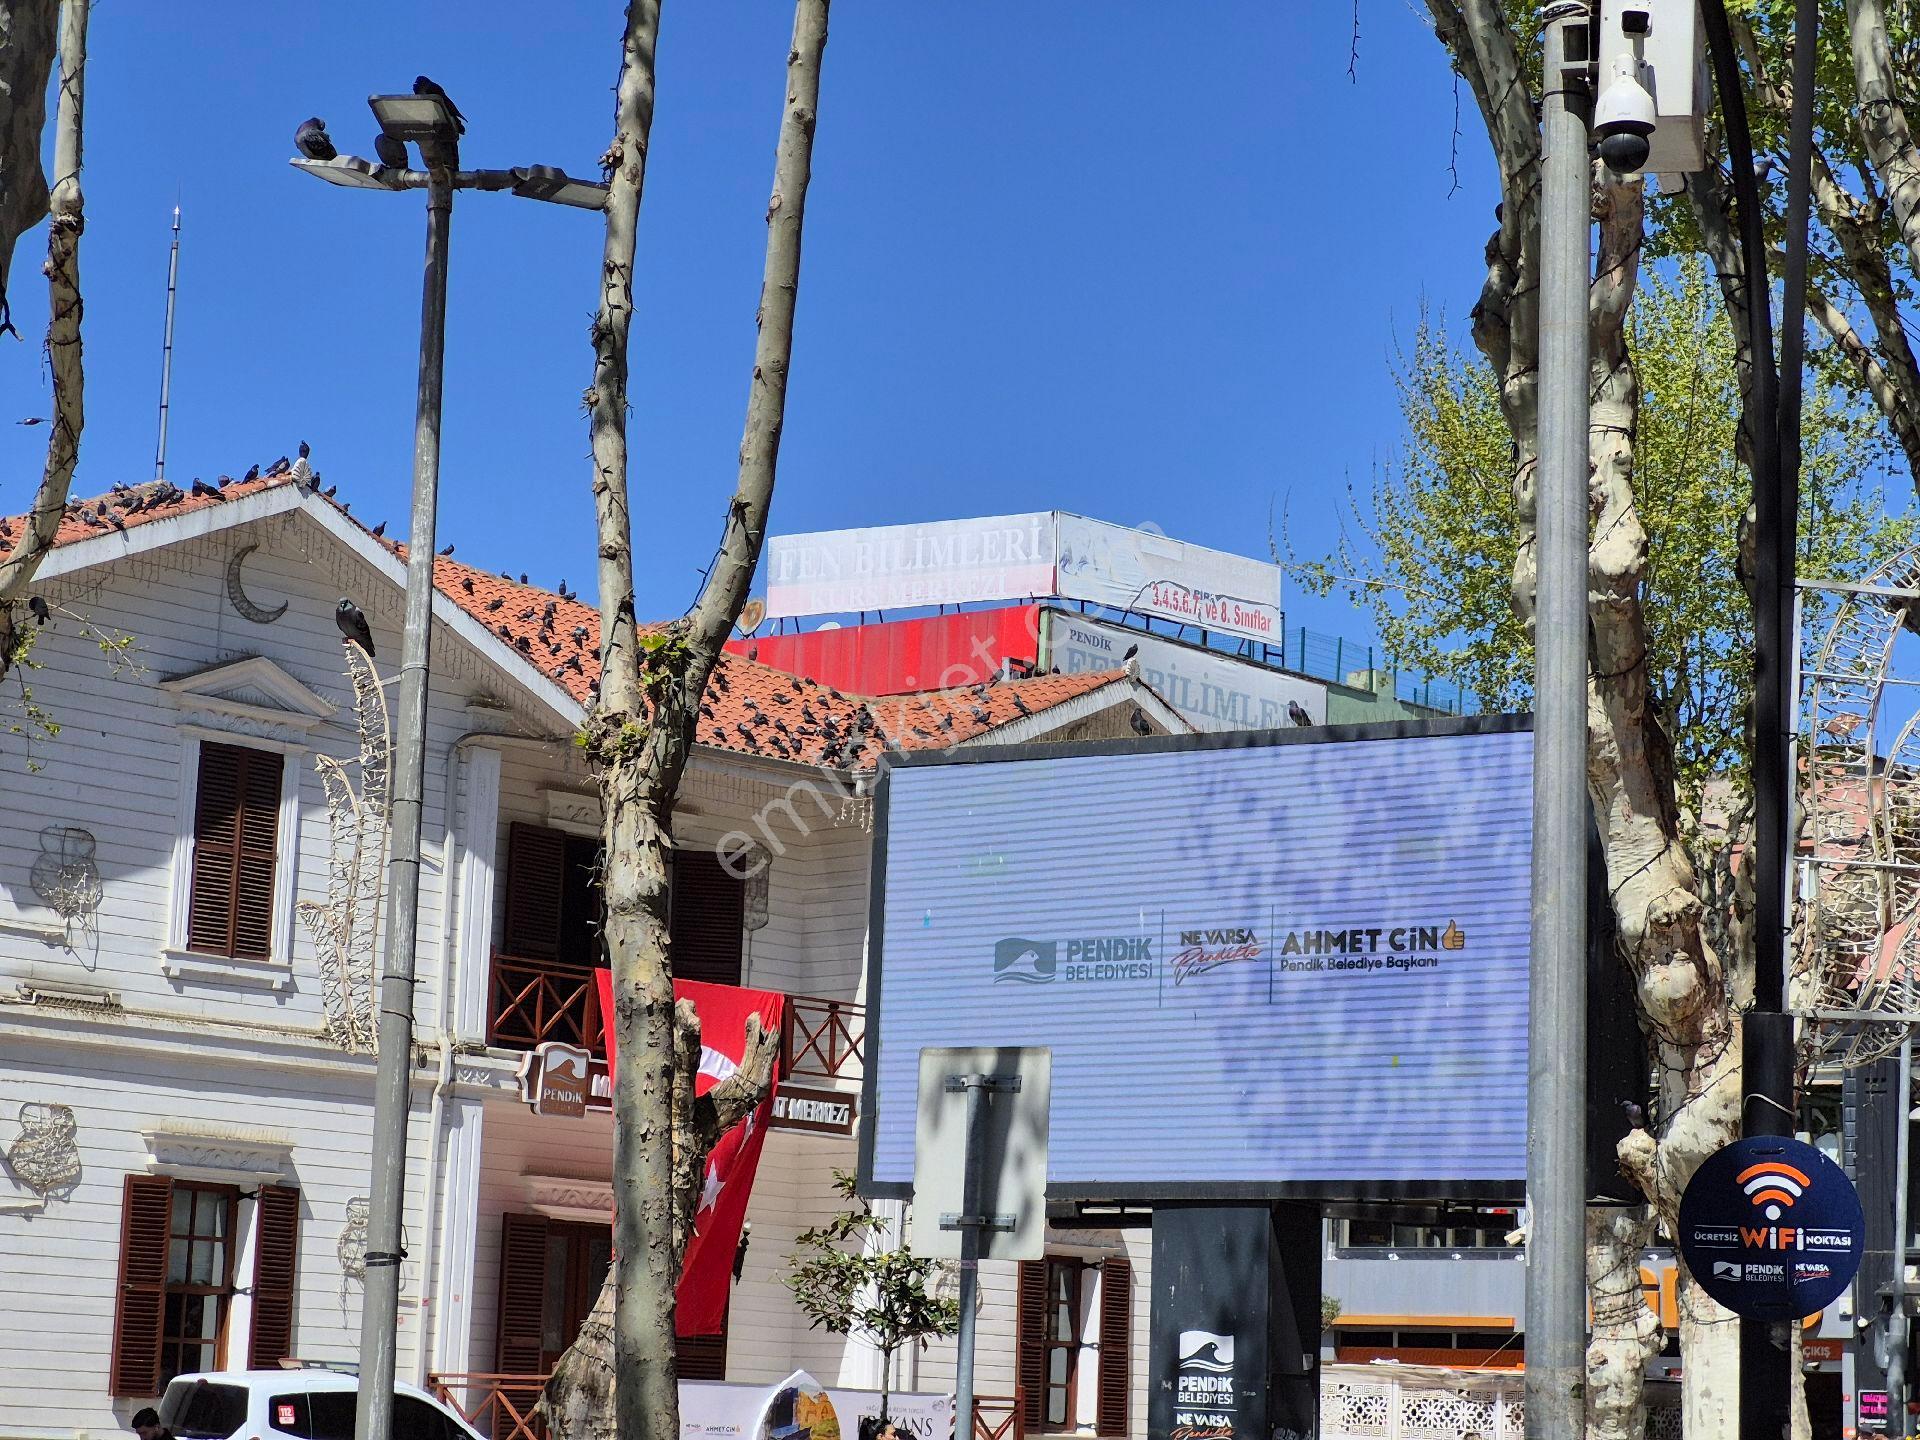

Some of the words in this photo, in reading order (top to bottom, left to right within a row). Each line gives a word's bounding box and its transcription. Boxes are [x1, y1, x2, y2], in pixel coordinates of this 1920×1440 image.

[777, 544, 842, 581] FEN
[1205, 602, 1218, 621] ve
[1234, 604, 1273, 633] Sınıflar
[1069, 627, 1112, 652] PENDİK
[1180, 930, 1202, 946] NE
[1204, 928, 1258, 945] VARSA
[1280, 929, 1383, 956] AHMET
[1280, 958, 1324, 972] Pendik
[1327, 956, 1382, 973] Belediye
[1386, 954, 1438, 972] Başkanı
[1805, 1234, 1852, 1247] NOKTASI
[1802, 1345, 1831, 1359] ÇIKIŞ
[1178, 1375, 1234, 1393] PENDİK
[280, 1407, 292, 1417] 112
[1176, 1412, 1193, 1425] NE
[1193, 1413, 1233, 1428] VARSA
